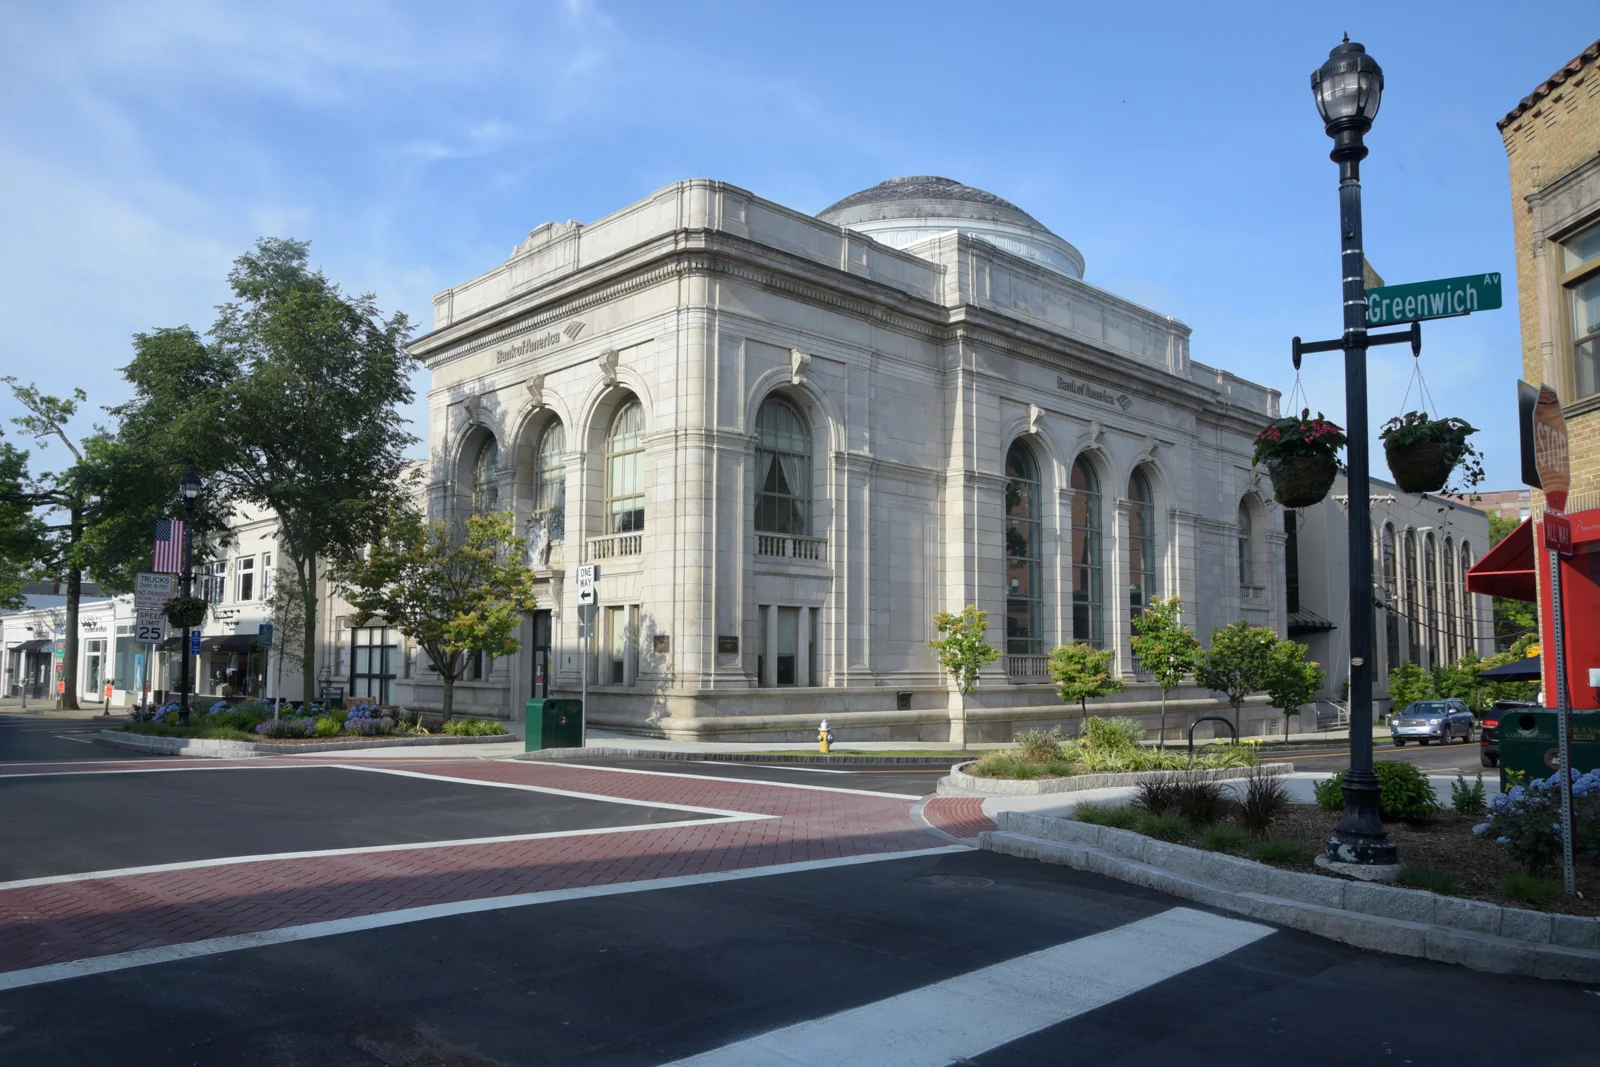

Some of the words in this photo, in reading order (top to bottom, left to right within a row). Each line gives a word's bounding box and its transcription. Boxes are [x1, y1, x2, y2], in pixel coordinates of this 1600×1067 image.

[1368, 283, 1478, 322] Greenwich
[1483, 273, 1500, 285] Av
[1536, 421, 1567, 474] STOP
[1547, 522, 1557, 543] ALL
[1558, 525, 1569, 545] WAY
[580, 567, 592, 577] ONE
[140, 575, 170, 584] TRUCKS
[580, 578, 592, 587] WAY
[139, 612, 164, 620] SPEED
[138, 626, 161, 640] 25
